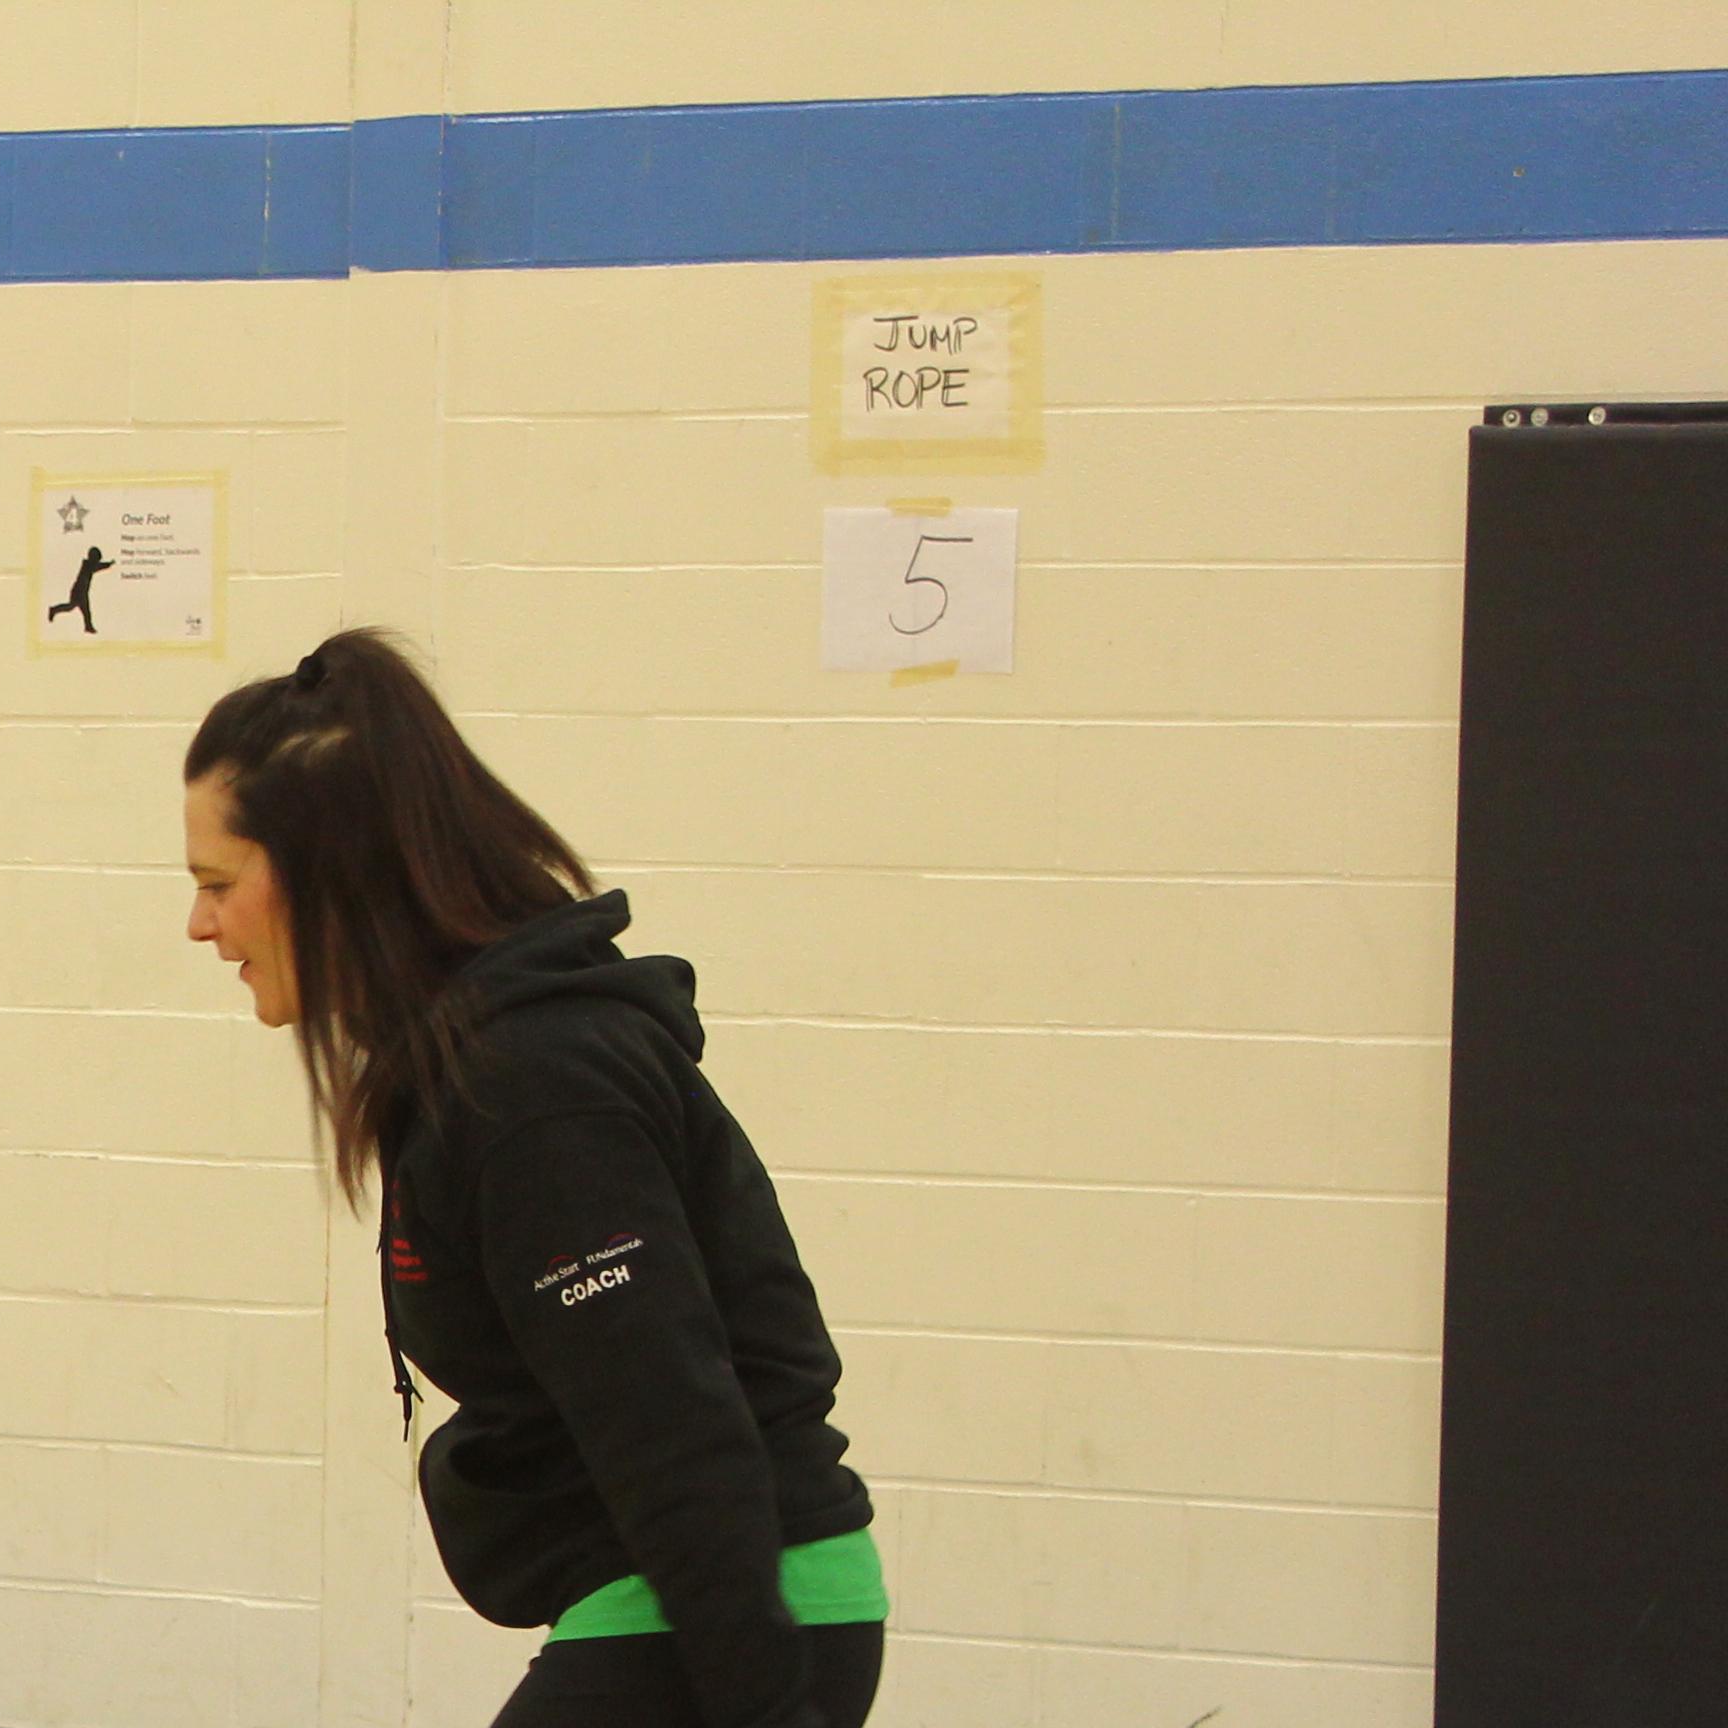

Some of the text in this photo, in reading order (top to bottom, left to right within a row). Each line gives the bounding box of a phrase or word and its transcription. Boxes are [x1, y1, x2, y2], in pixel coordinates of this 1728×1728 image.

[873, 315, 978, 355] JUMP
[863, 367, 970, 412] ROPE
[121, 512, 171, 526] One Foot
[889, 535, 974, 635] 5
[561, 1264, 631, 1306] COACH
